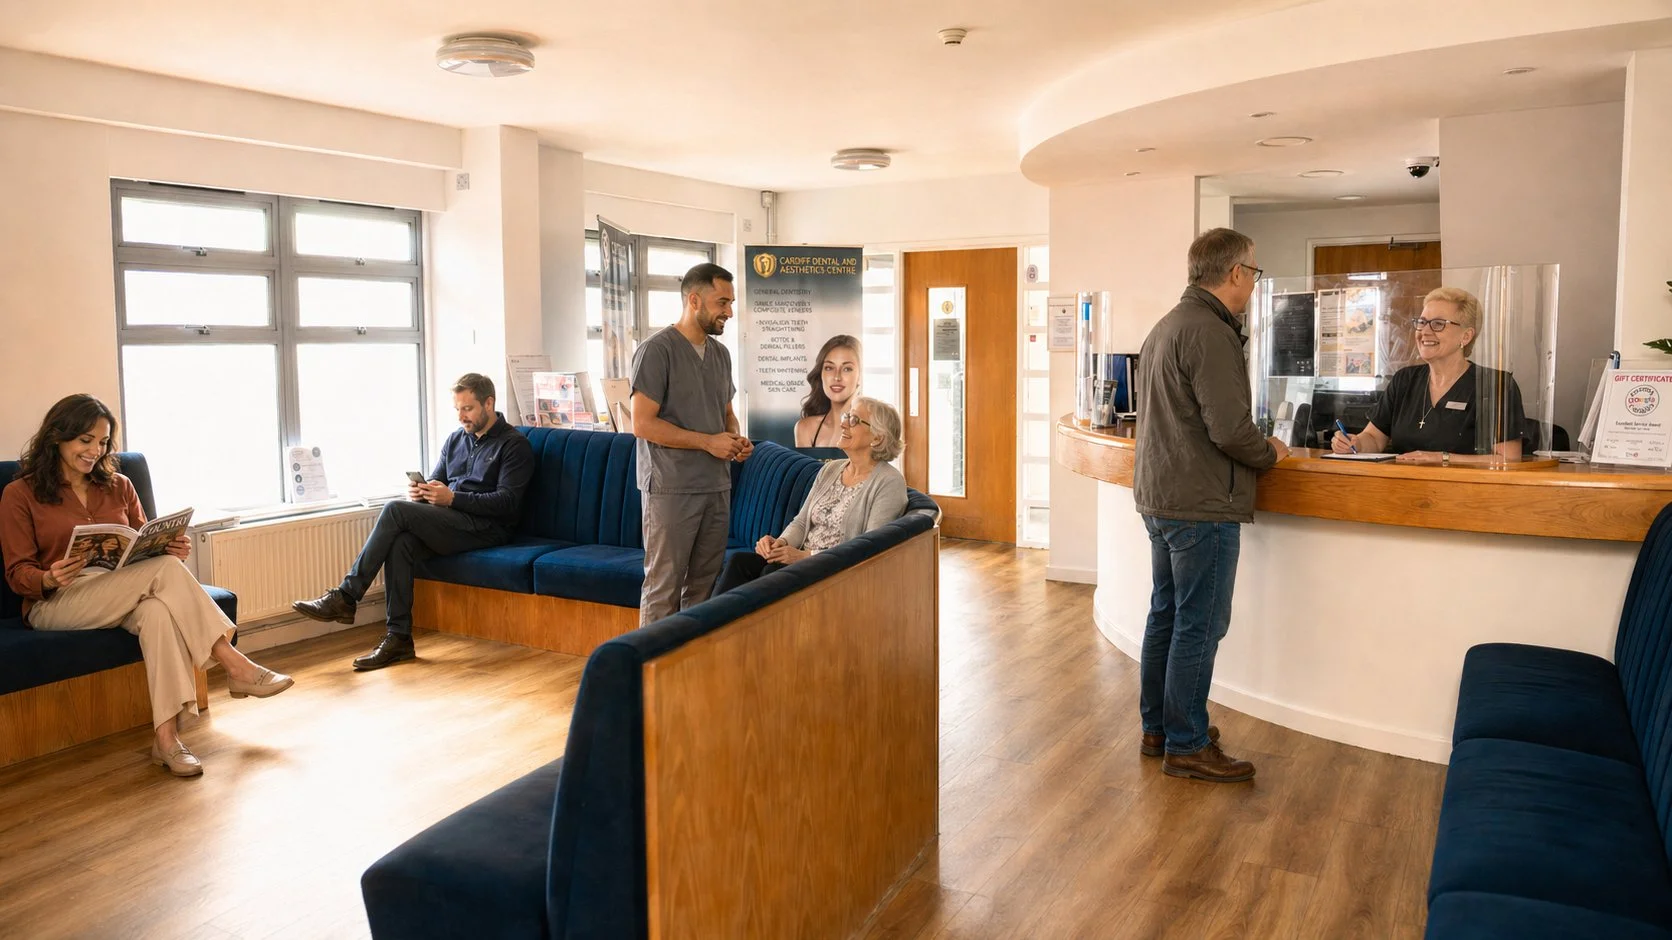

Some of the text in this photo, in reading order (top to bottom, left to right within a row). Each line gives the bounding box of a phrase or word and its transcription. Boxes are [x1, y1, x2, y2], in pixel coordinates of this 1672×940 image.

[780, 256, 857, 266] CARDIFF DENTAL AND
[780, 266, 856, 274] AESTHETICS CENTRE
